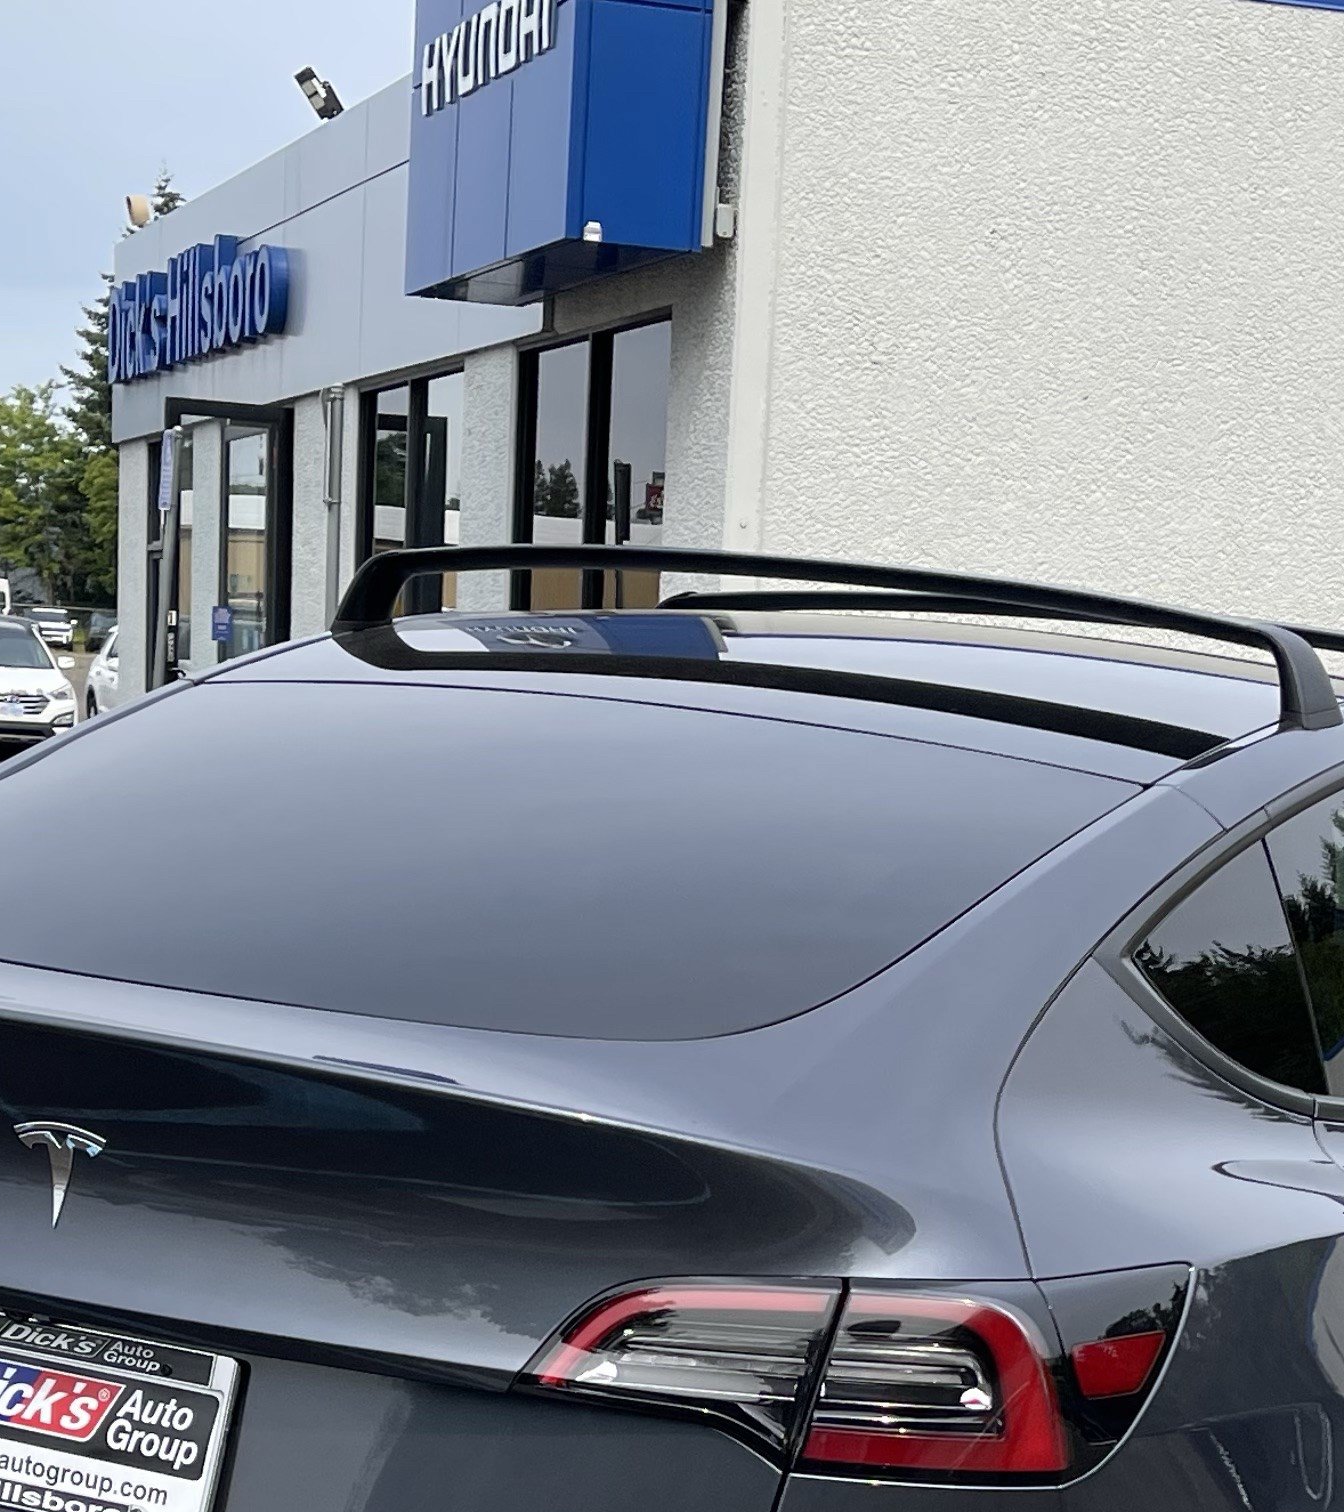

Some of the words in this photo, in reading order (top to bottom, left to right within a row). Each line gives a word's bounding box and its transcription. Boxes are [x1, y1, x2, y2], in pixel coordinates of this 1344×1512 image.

[421, 0, 552, 116] HYUNDAI
[166, 234, 273, 365] Hillsboro
[1, 1322, 98, 1355] Dick's
[110, 1339, 155, 1359] Auto
[103, 1350, 162, 1373] Group
[115, 1389, 194, 1432] Auto
[106, 1419, 199, 1471] Group
